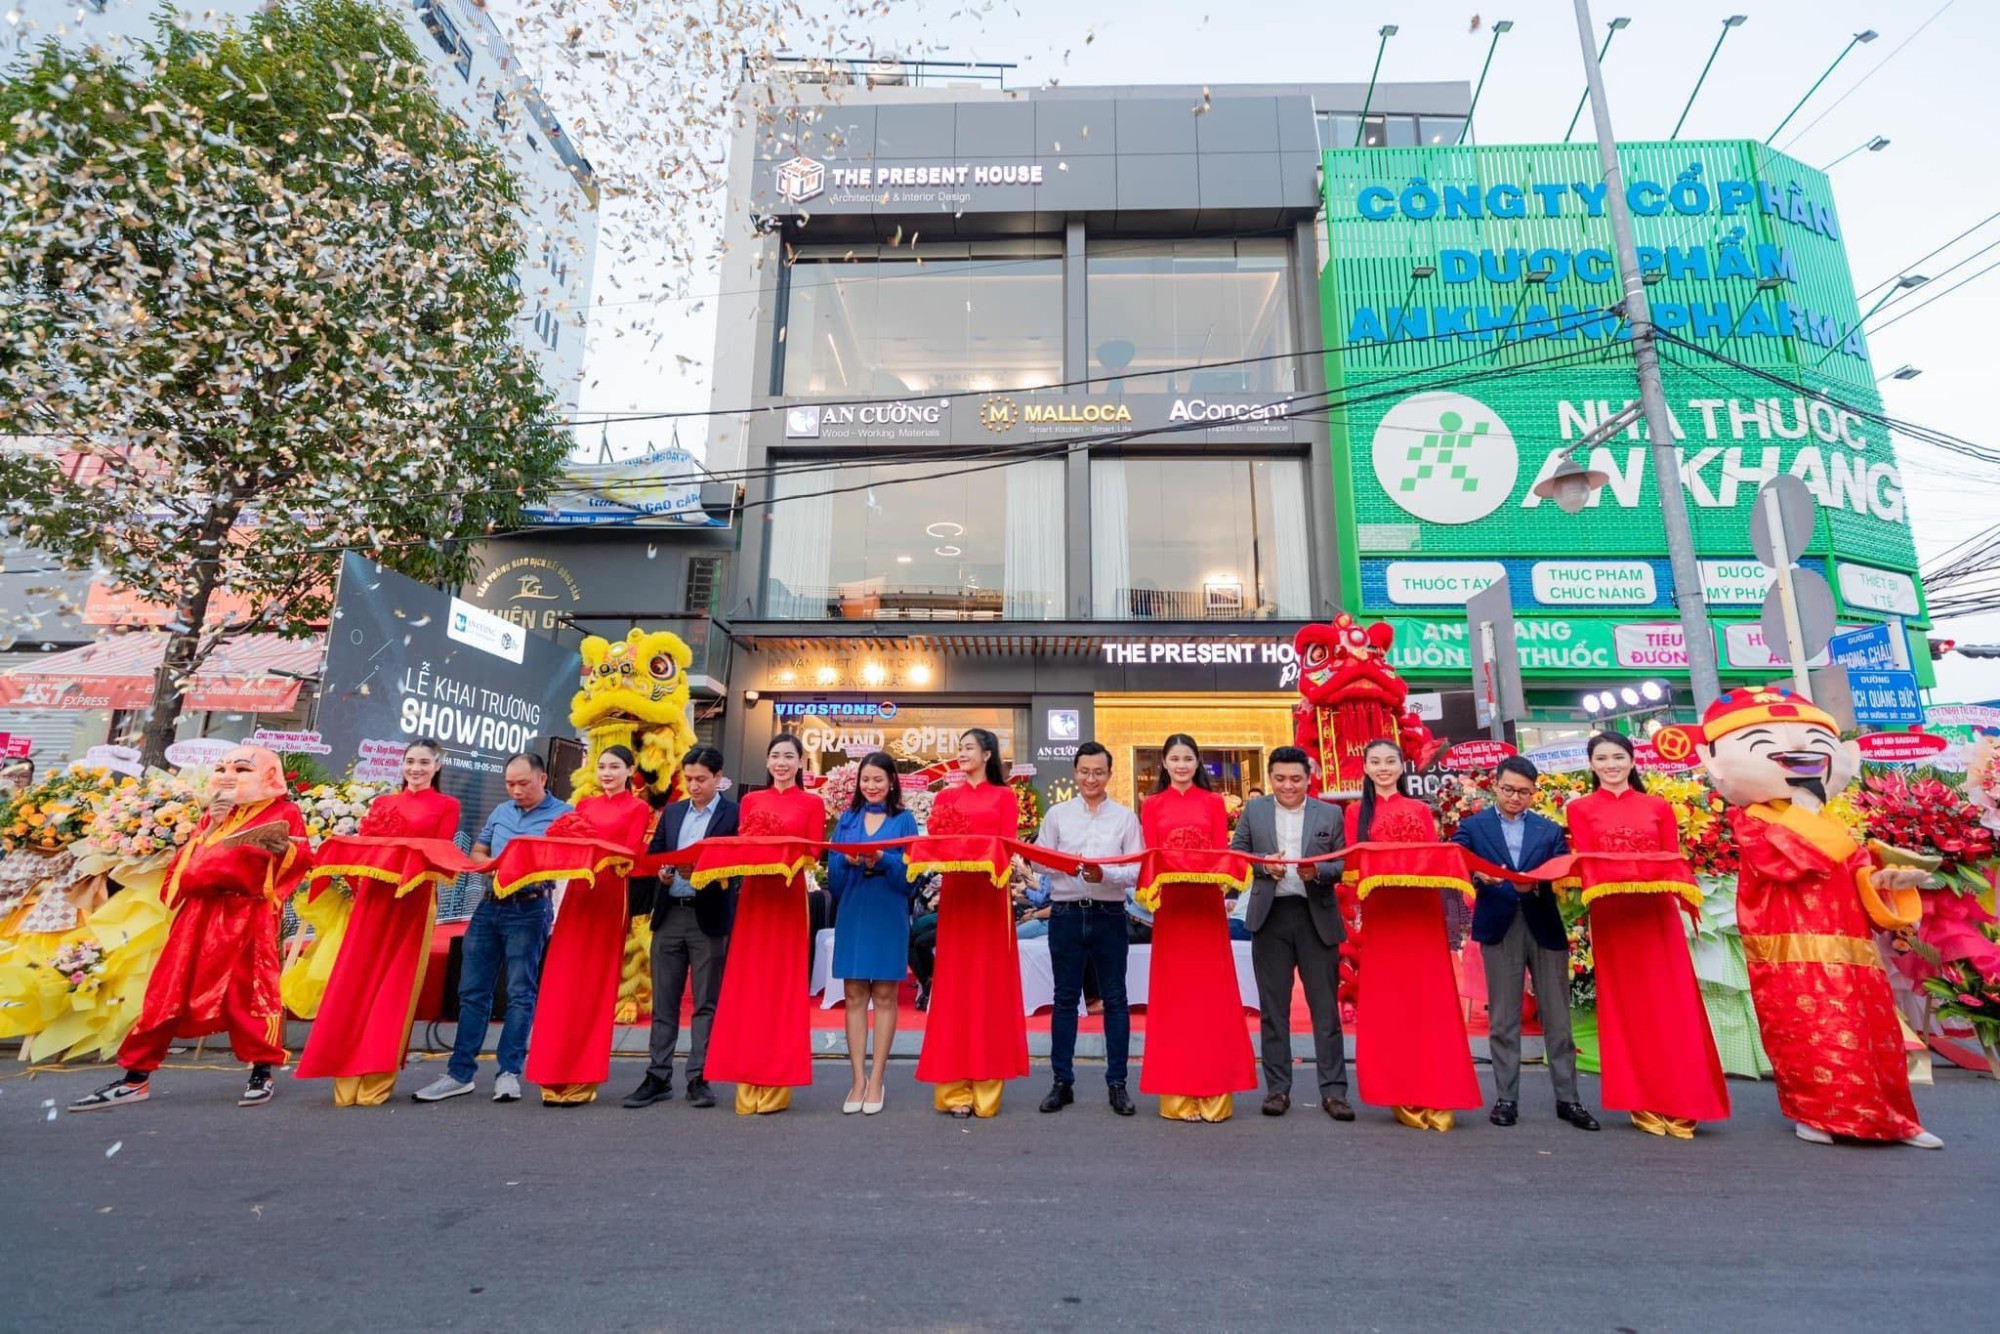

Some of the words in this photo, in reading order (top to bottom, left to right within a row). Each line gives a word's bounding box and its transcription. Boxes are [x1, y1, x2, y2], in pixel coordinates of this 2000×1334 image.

[832, 168, 871, 186] THE
[877, 167, 969, 186] PRESENT
[974, 166, 1043, 184] HOUSE
[831, 192, 890, 204] Architecture
[892, 193, 900, 203] &
[902, 192, 936, 203] Interior
[938, 192, 971, 204] Design
[1357, 177, 1527, 221] CÔNG
[1533, 182, 1608, 219] TY
[1626, 162, 1710, 217] CỔ
[1717, 179, 1838, 242] PHẦN
[1440, 247, 1615, 294] DƯỢC
[1635, 226, 1798, 284] PHẨM
[1347, 305, 1428, 343] AN
[1434, 303, 1636, 341] KHANG
[1653, 300, 1867, 362] PHARMA
[821, 405, 856, 424] AN
[859, 401, 941, 424] CƯỜNG
[989, 408, 1009, 423] M
[1024, 404, 1133, 423] MALLOCA
[1168, 399, 1290, 425] AConcept
[821, 428, 850, 438] Wood
[857, 428, 896, 440] Working
[899, 428, 941, 438] Materials
[1028, 425, 1052, 433] Smart
[1091, 425, 1115, 433] Smart
[1117, 425, 1132, 433] Life
[1519, 446, 1647, 509] AN
[1658, 445, 1904, 524] KHANG
[511, 557, 529, 569] GIAO
[1735, 584, 1768, 600] PHẨ
[1422, 622, 1464, 641] AN
[1513, 620, 1573, 641] ANG
[1101, 643, 1147, 664] THE
[1150, 643, 1256, 664] PRESENT
[1262, 643, 1301, 664] HO
[1392, 642, 1467, 667] LUÔN
[1516, 640, 1610, 668] THUỐC
[1630, 647, 1690, 664] ĐƯỜN
[1867, 640, 1893, 664] CHÂU
[64, 695, 110, 707] EXPRESS
[405, 661, 431, 697] LỄ
[434, 675, 477, 709] KHAI
[480, 689, 541, 725] TRƯƠNG
[1852, 686, 1868, 708] ÍCH
[1868, 685, 1898, 709] QUẢNG
[1897, 686, 1917, 708] ĐỨC
[774, 703, 878, 716] VICOSTONE
[400, 697, 539, 754] SHOWROOM
[801, 727, 886, 753] GRAND
[902, 726, 1011, 754] OPENG
[1037, 746, 1052, 757] AN
[452, 757, 474, 770] TRANG,
